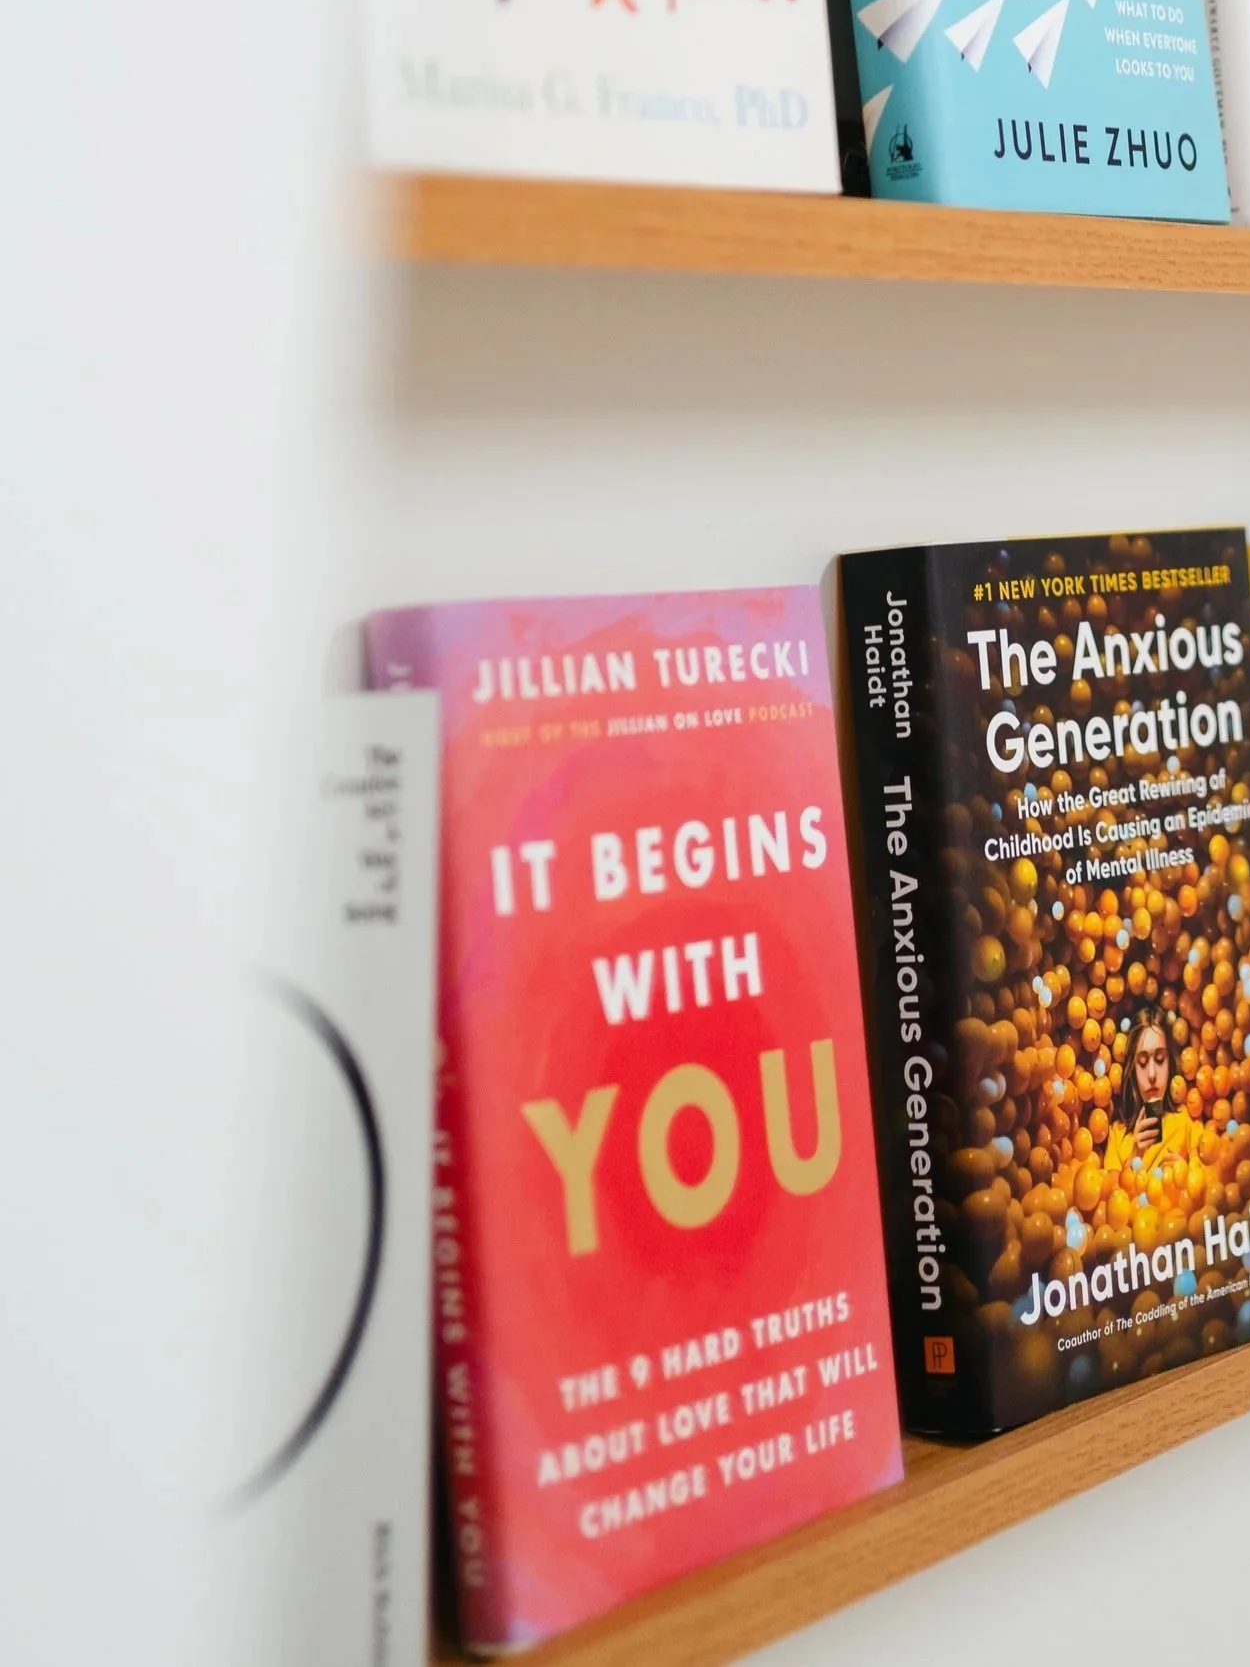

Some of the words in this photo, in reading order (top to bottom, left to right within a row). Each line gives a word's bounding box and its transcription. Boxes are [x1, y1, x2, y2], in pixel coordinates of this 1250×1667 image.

[1105, 26, 1140, 46] WHEN
[1142, 32, 1198, 55] EVERYONE
[1115, 0, 1147, 19] WHAT
[1150, 4, 1166, 21] TO
[1168, 6, 1184, 24] DO
[1115, 57, 1154, 78] LOOKS
[1156, 62, 1171, 79] TO
[1172, 64, 1195, 82] YOU
[994, 117, 1090, 165] JULIE
[1105, 126, 1198, 172] ZHUO
[973, 582, 993, 602] #1
[998, 579, 1035, 601] NEW
[1041, 575, 1085, 597] YORK
[1090, 572, 1137, 594] TIMES
[1141, 565, 1232, 590] BESTSELLER
[472, 650, 636, 704] JILLIAN
[653, 640, 809, 688] TURECKI
[864, 623, 887, 709] Haidt
[886, 590, 914, 740] Jonathan
[966, 628, 1057, 691] The
[1072, 613, 1244, 681] Anxious
[674, 711, 699, 730] ON
[704, 707, 742, 727] LOVE
[748, 702, 813, 722] PODCAST
[986, 690, 1244, 773] Generation
[882, 775, 913, 857] The
[1017, 794, 1055, 821] How
[1057, 788, 1085, 813] the
[1089, 782, 1137, 810] Great
[1139, 774, 1207, 806] Rewiring
[1208, 768, 1227, 792] of
[491, 841, 555, 918] IT
[591, 806, 828, 902] BEGINS
[984, 826, 1075, 862] Childhood
[1078, 824, 1092, 845] Is
[1095, 813, 1161, 847] Causing
[1164, 814, 1186, 833] an
[1066, 863, 1083, 885] of
[1086, 853, 1144, 881] Mental
[1145, 846, 1194, 872] Illness
[593, 931, 764, 1026] WITH
[889, 868, 926, 1044] Anxious
[521, 1039, 843, 1257] YOU
[903, 1055, 947, 1312] Generation
[1020, 1236, 1196, 1326] Jonathan
[1057, 1327, 1102, 1351] Coauthor
[1104, 1323, 1114, 1336] of
[1116, 1317, 1133, 1332] The
[1135, 1303, 1177, 1326] Coddling
[1178, 1298, 1189, 1310] of
[1189, 1292, 1205, 1305] the
[1206, 1279, 1248, 1301] American
[558, 1364, 621, 1412] THE
[630, 1356, 652, 1391] 9
[663, 1327, 742, 1380] HARD
[752, 1291, 851, 1350] TRUTHS
[537, 1423, 647, 1488] ABOUT
[657, 1395, 730, 1446] LOVE
[741, 1366, 808, 1416] THAT
[817, 1343, 879, 1388] WILL
[579, 1465, 708, 1539] CHANGE
[717, 1434, 795, 1488] YOUR
[805, 1411, 856, 1454] LIFE
